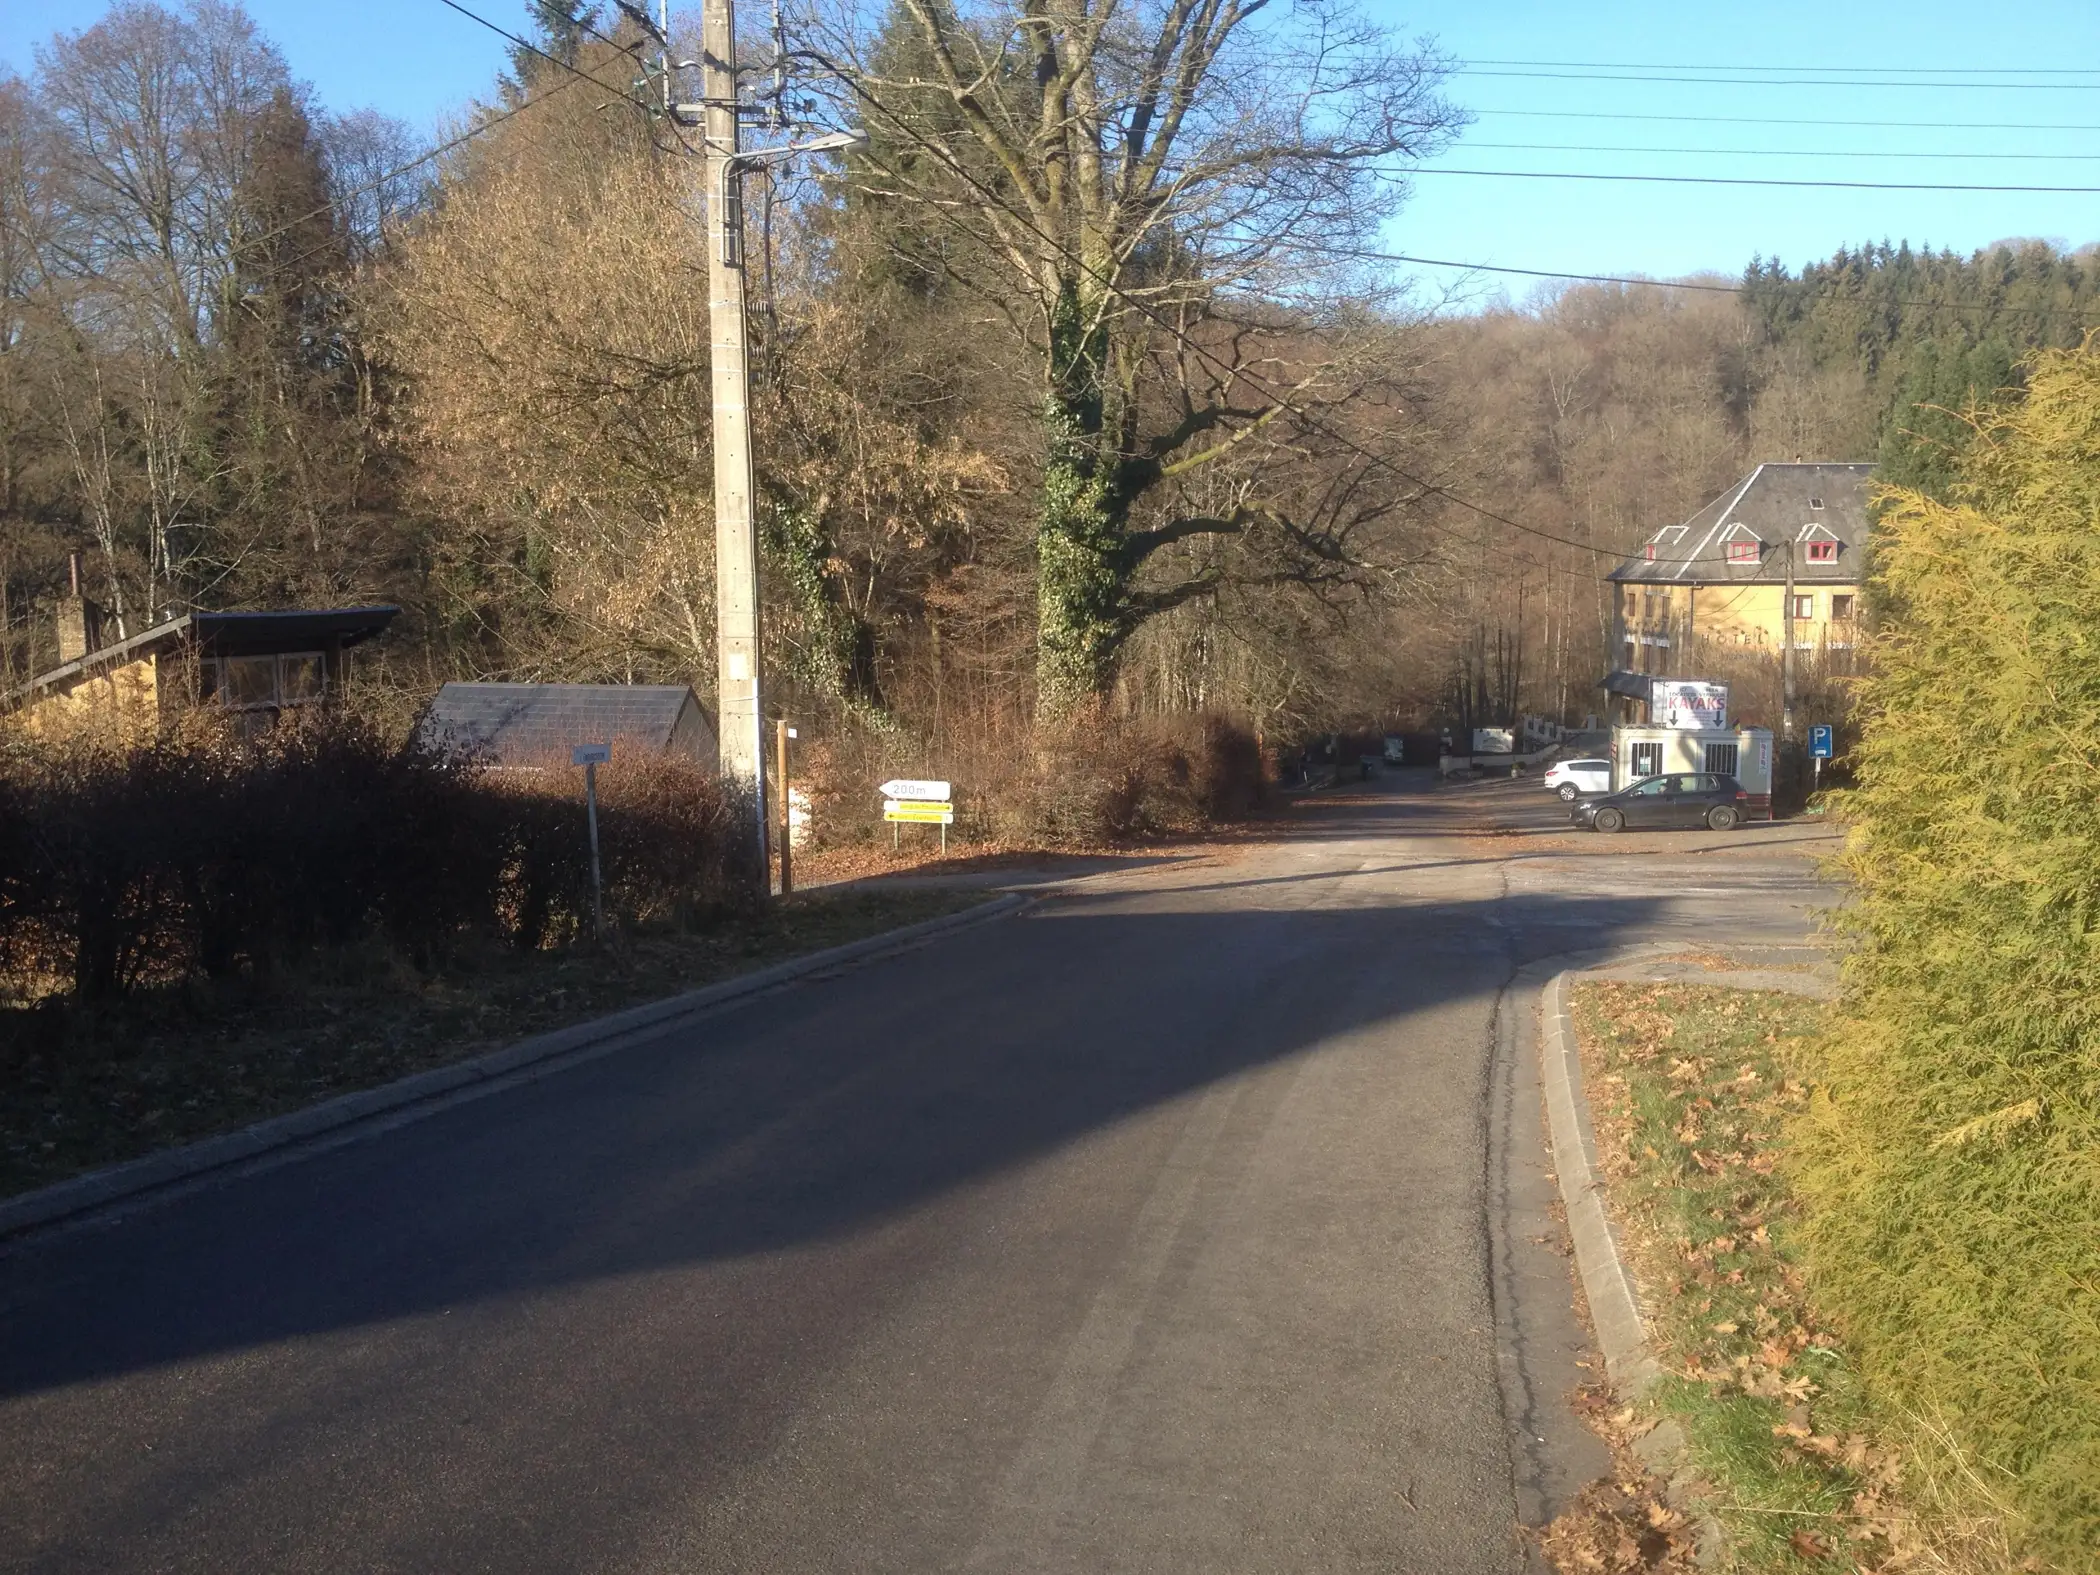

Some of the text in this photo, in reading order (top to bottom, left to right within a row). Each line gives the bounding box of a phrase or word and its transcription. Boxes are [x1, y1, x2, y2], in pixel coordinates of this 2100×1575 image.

[1701, 633, 1764, 644] HOTEL
[1668, 696, 1726, 710] KAYAKS
[1814, 727, 1826, 744] P
[893, 784, 926, 795] 200m
